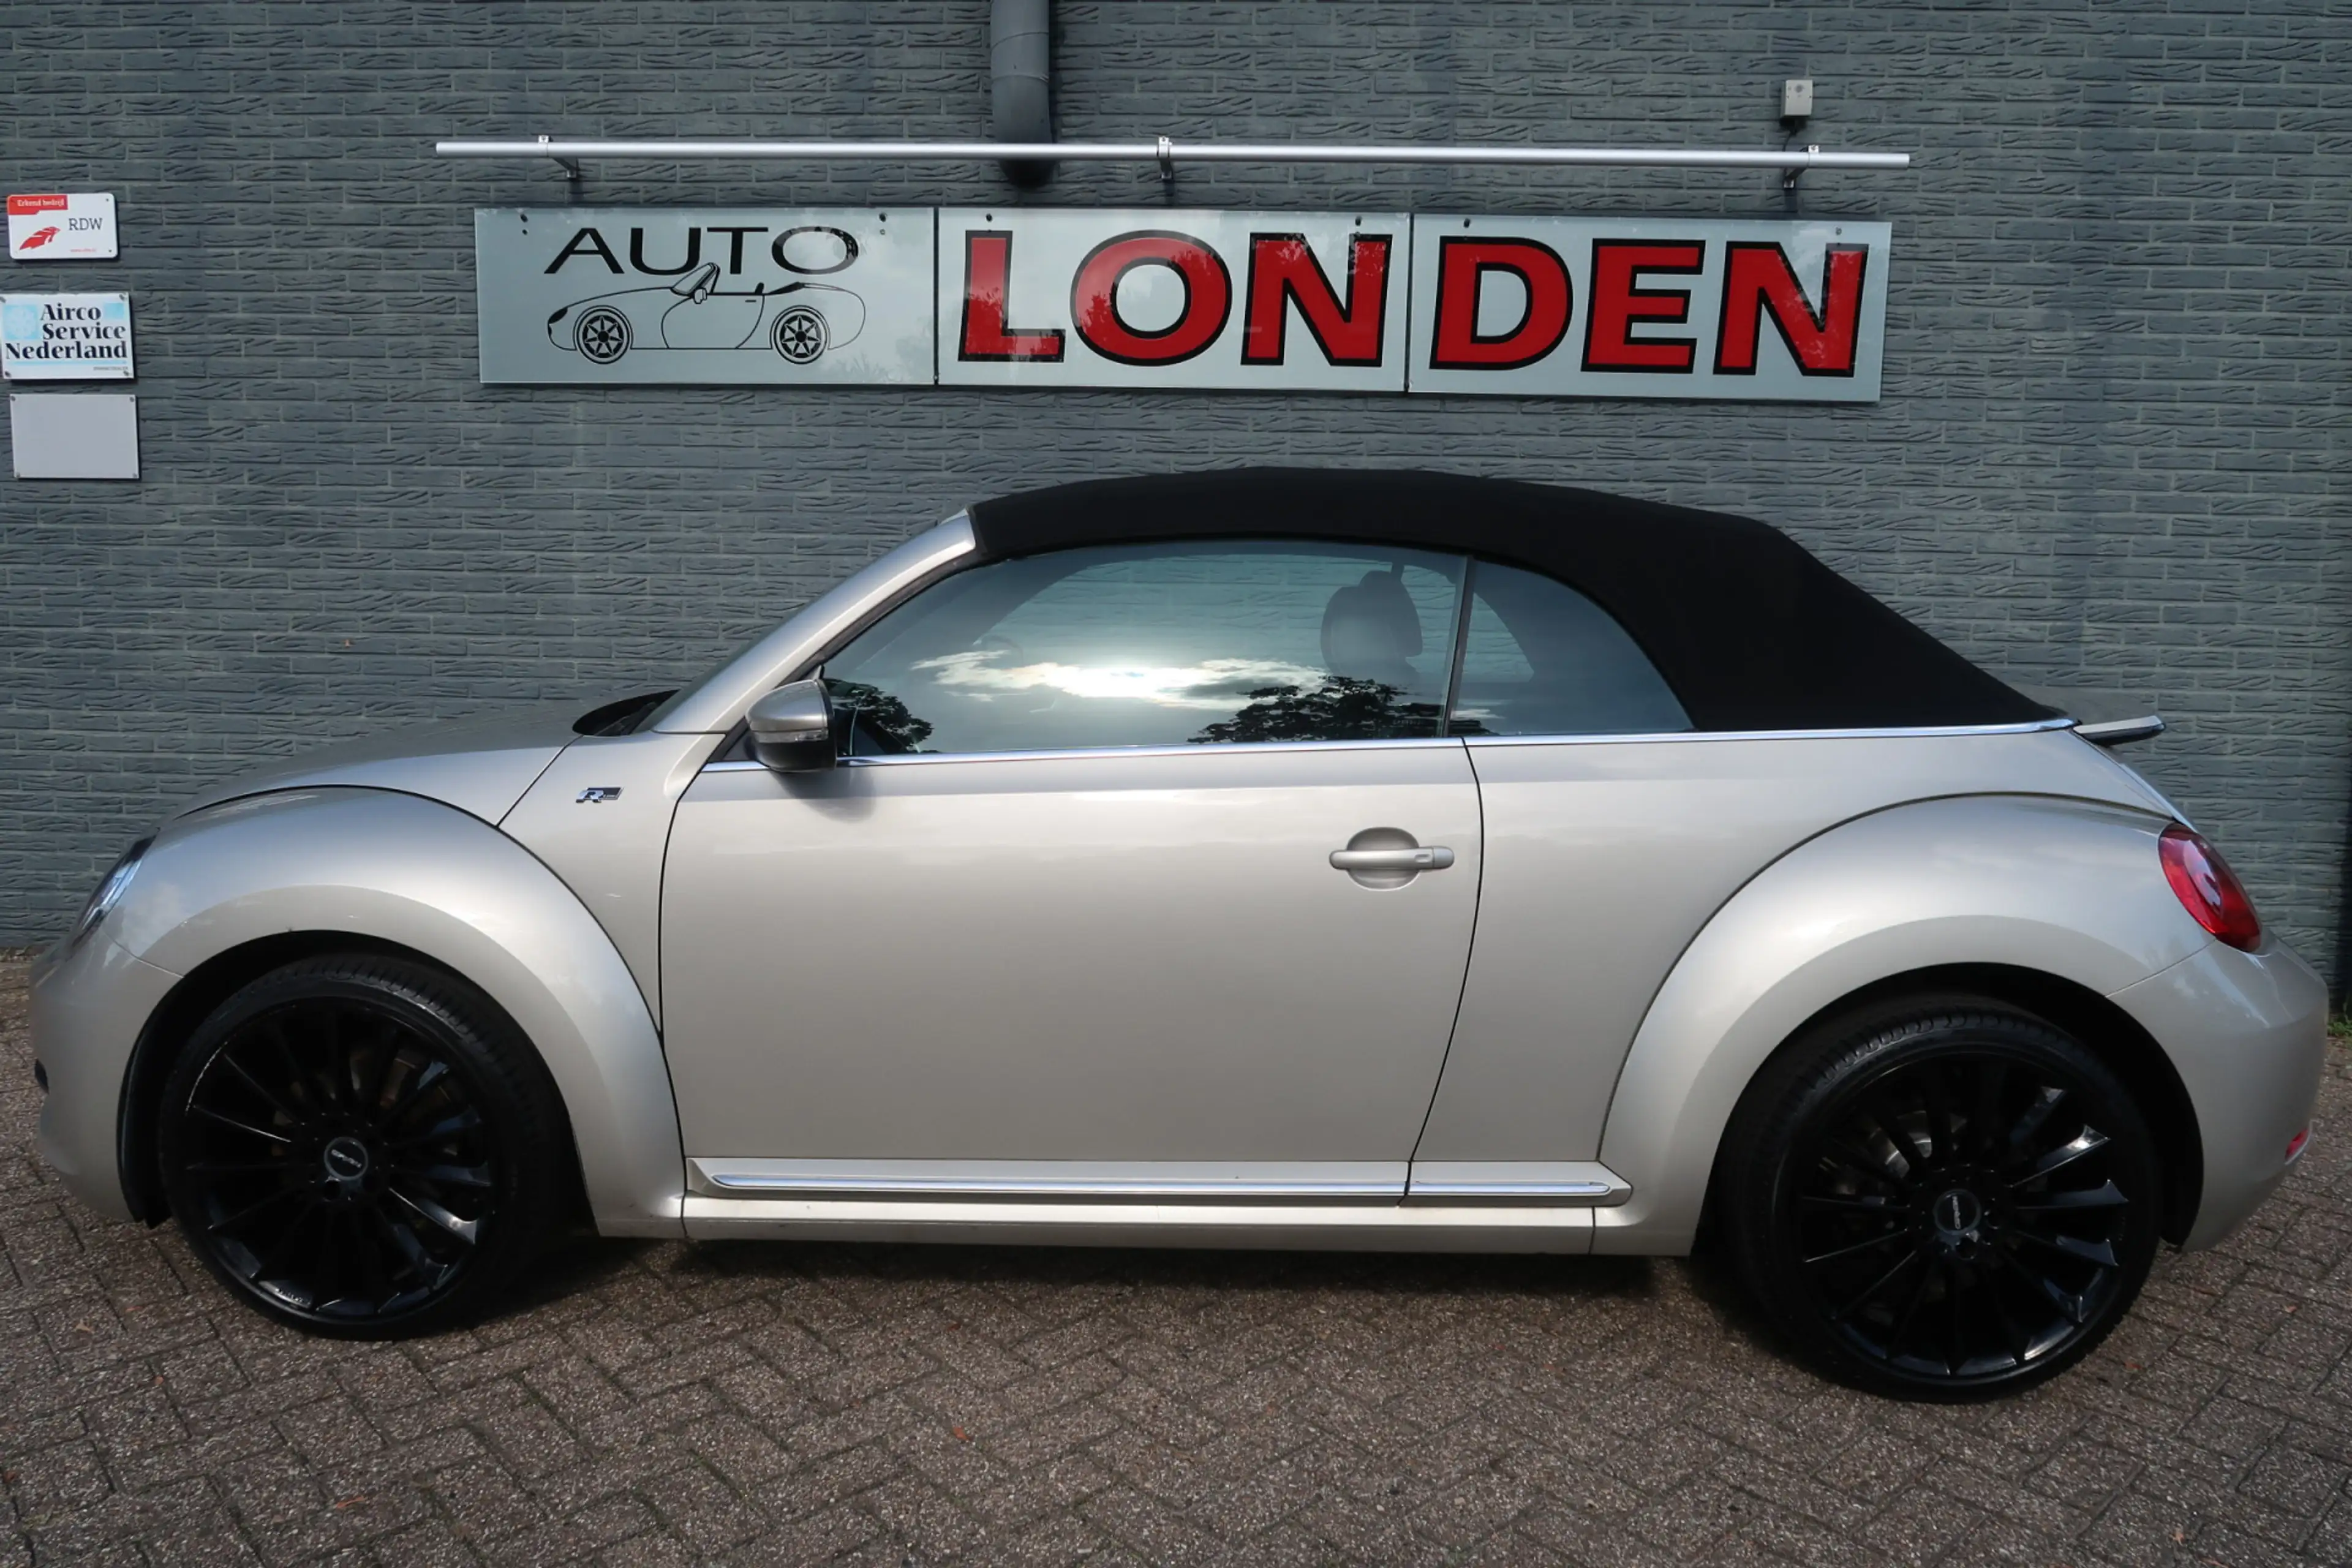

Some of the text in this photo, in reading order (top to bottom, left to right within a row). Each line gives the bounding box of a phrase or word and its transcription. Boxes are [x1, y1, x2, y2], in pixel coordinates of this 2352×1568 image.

[69, 217, 103, 230] RDW
[544, 226, 1869, 378] AUTO LONDEN
[40, 303, 102, 320] Airco
[42, 322, 126, 340] Service
[5, 341, 128, 359] Nederland
